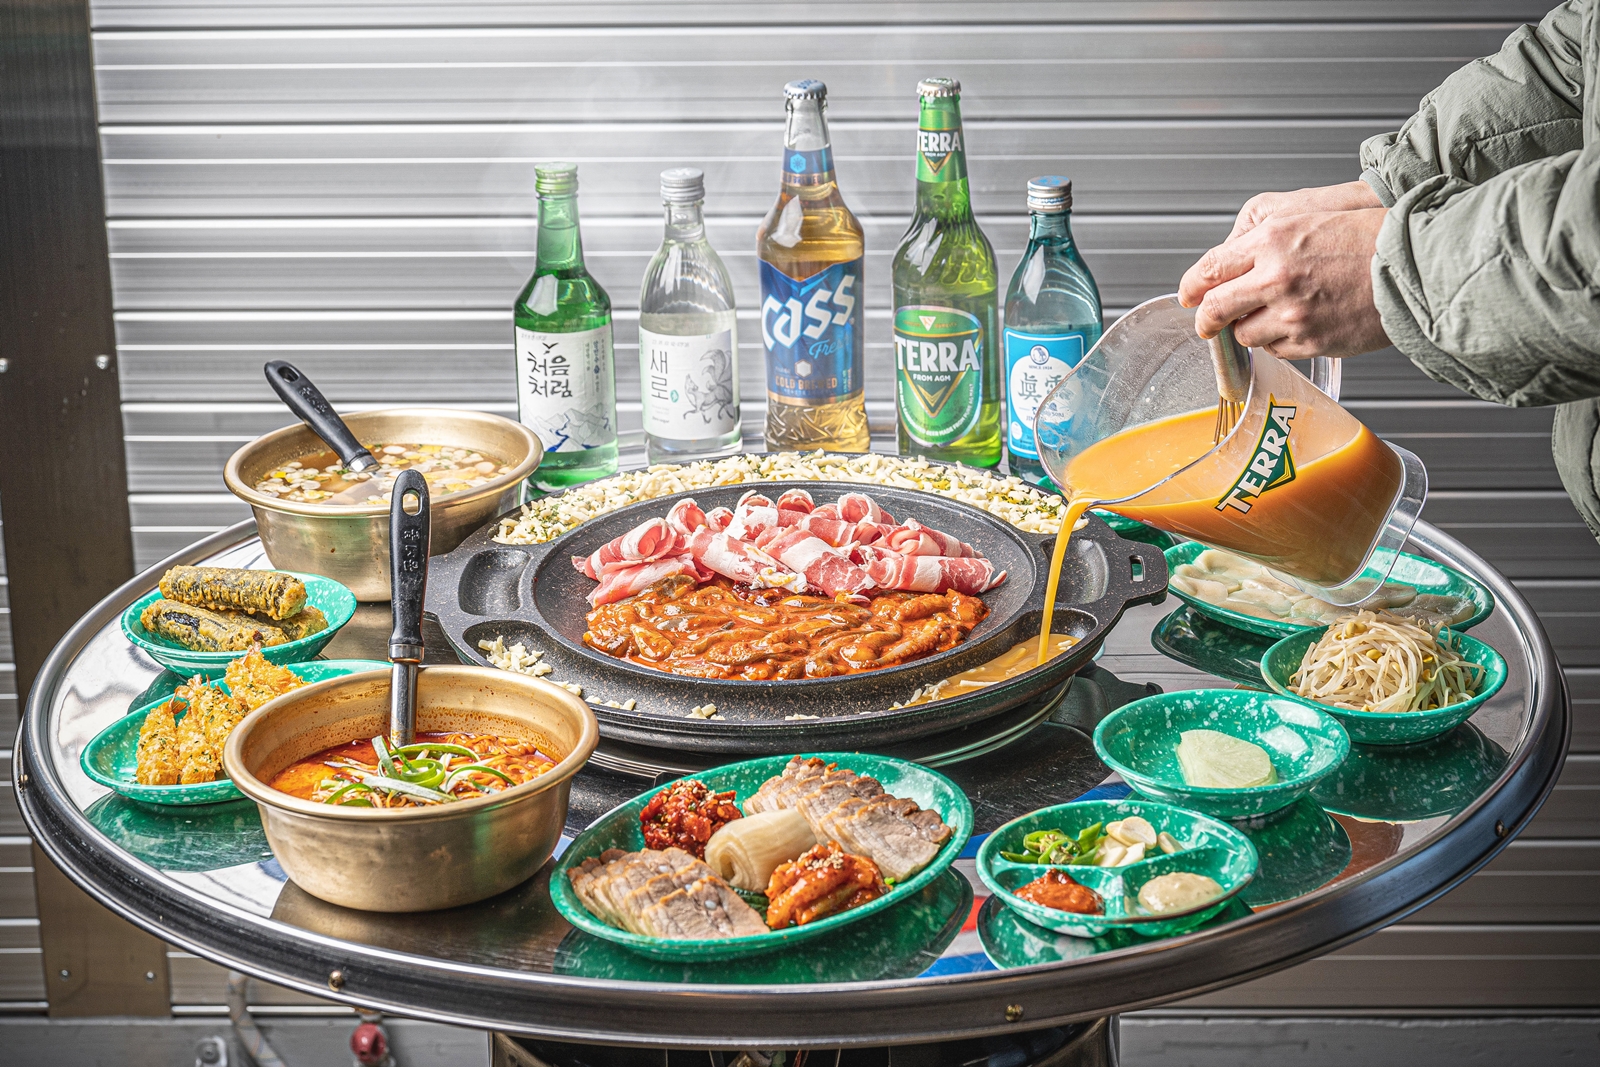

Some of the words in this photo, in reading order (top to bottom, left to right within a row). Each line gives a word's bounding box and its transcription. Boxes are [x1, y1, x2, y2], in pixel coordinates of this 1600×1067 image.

[917, 130, 962, 152] TERRA
[527, 351, 571, 377] 처음
[894, 334, 980, 373] TERRA
[528, 375, 573, 398] 처럼
[650, 349, 669, 400] 새로
[775, 375, 796, 390] COLD
[798, 379, 838, 391] BREWED
[912, 373, 932, 382] FROM
[1214, 406, 1297, 514] TERRA
